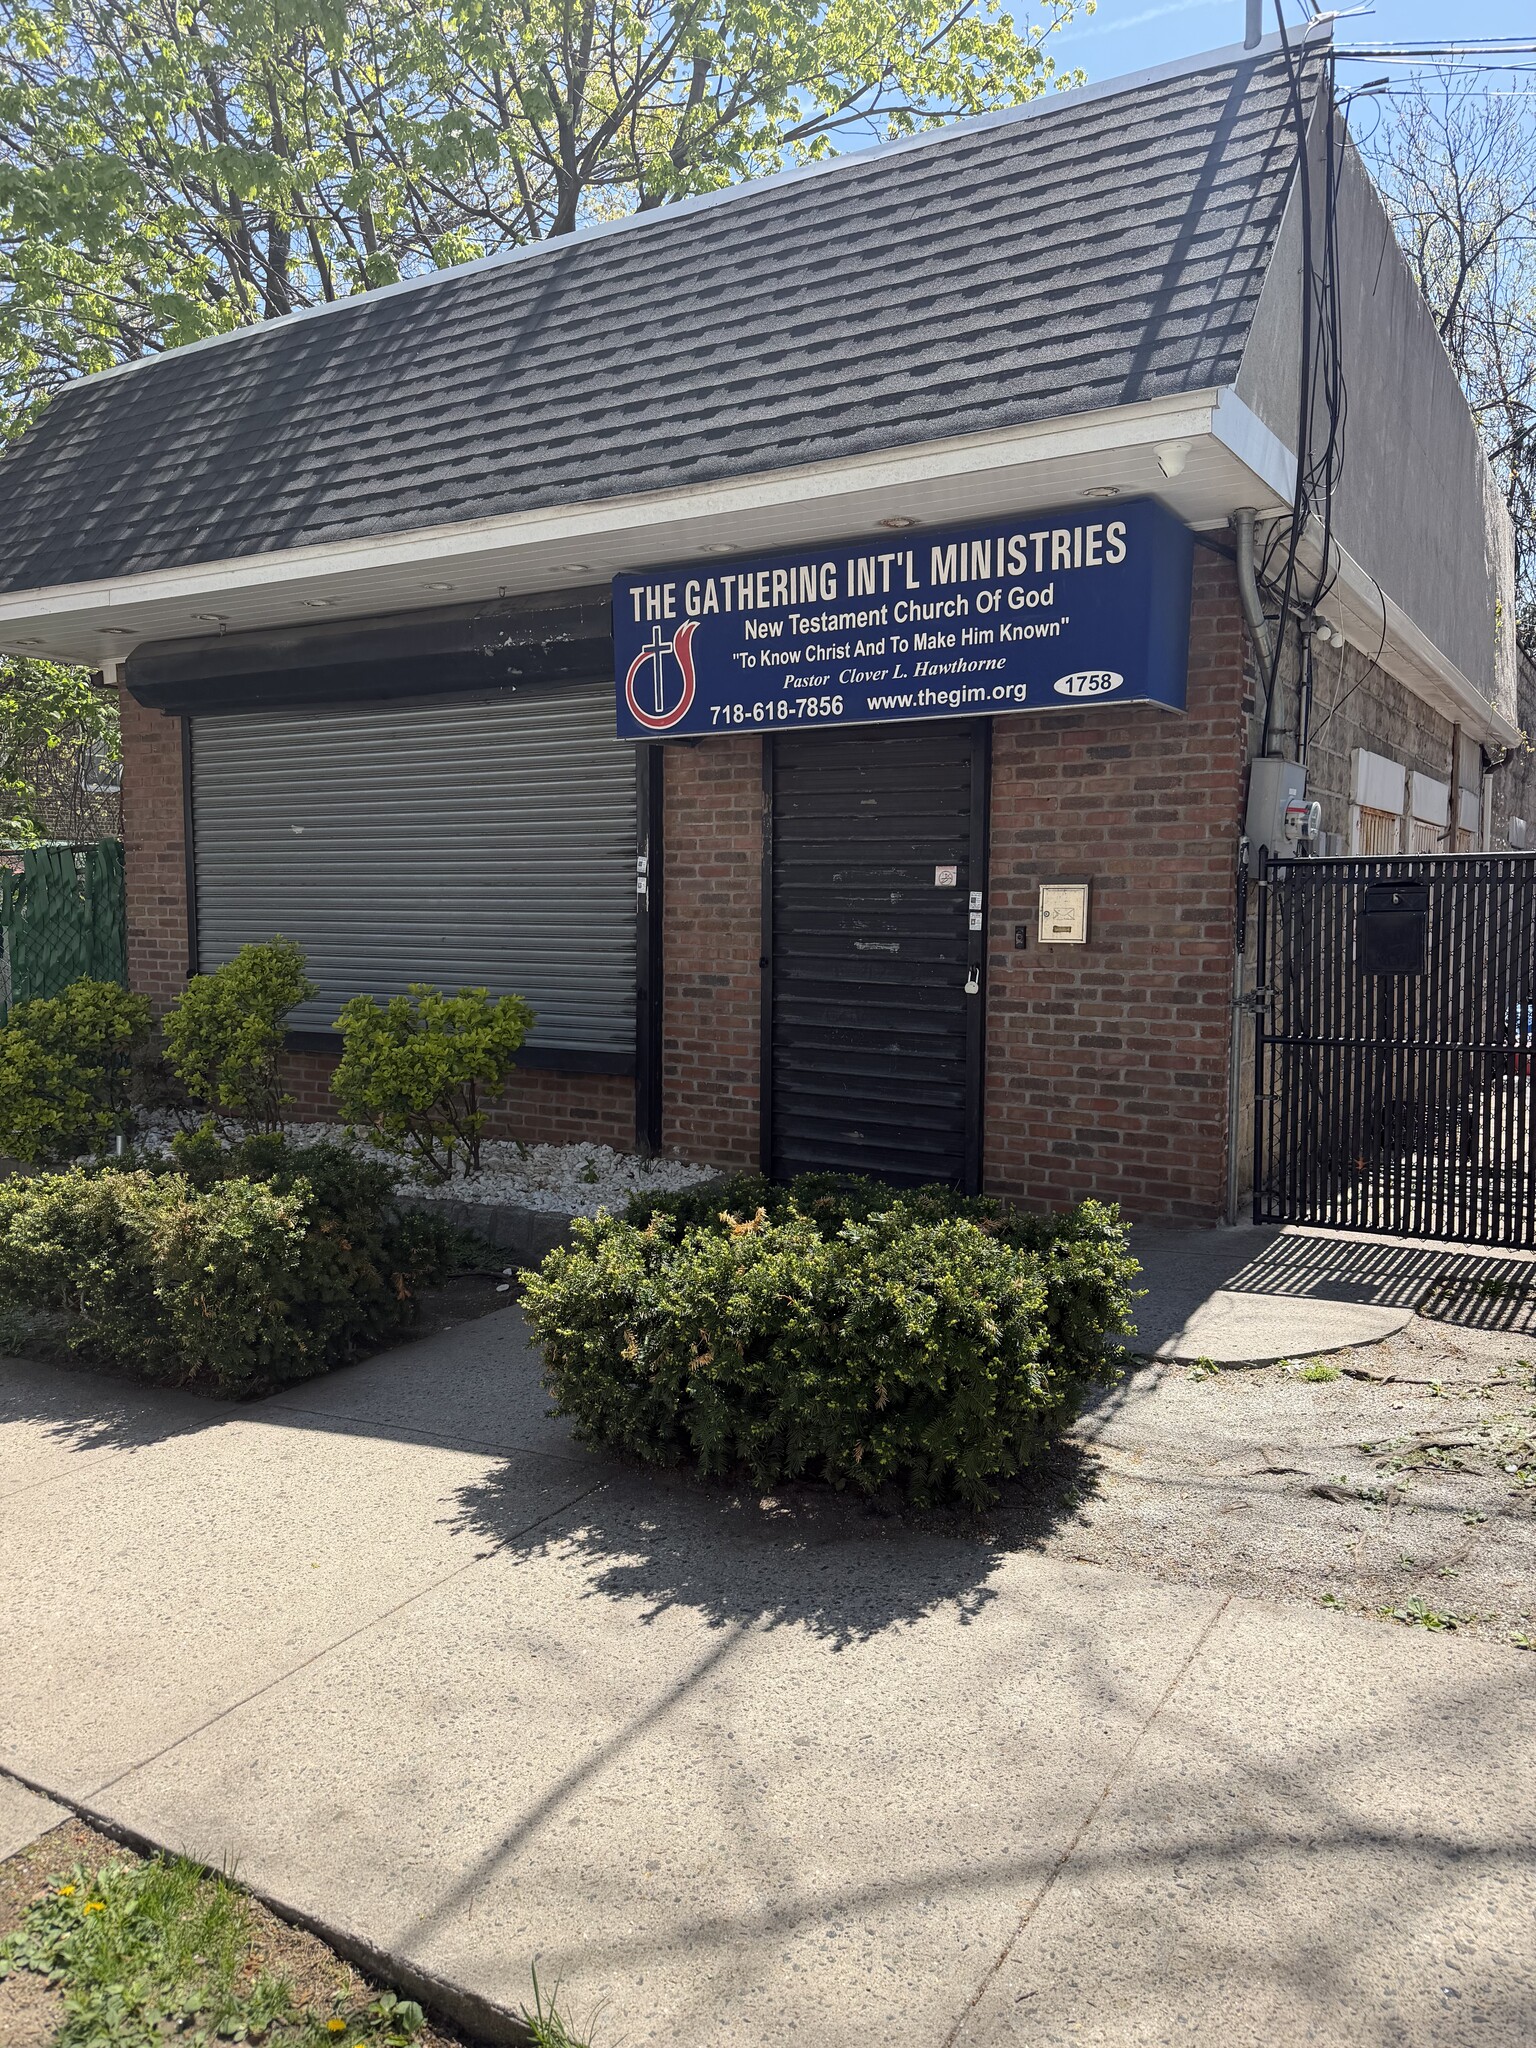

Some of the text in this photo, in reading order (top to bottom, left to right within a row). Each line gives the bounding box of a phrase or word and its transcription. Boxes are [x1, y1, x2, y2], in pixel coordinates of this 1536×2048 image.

[629, 521, 1127, 622] THE GATHERING INT'L MINISTRIES
[745, 582, 1054, 641] New Testament Church Of God
[732, 616, 1070, 669] "To Know Christ And To Make Him Known"
[783, 657, 1007, 690] Pastor Clover L. Hawthorne
[1065, 673, 1112, 693] 1758
[710, 683, 1028, 725] 718-618-7856 www.thegim.org
